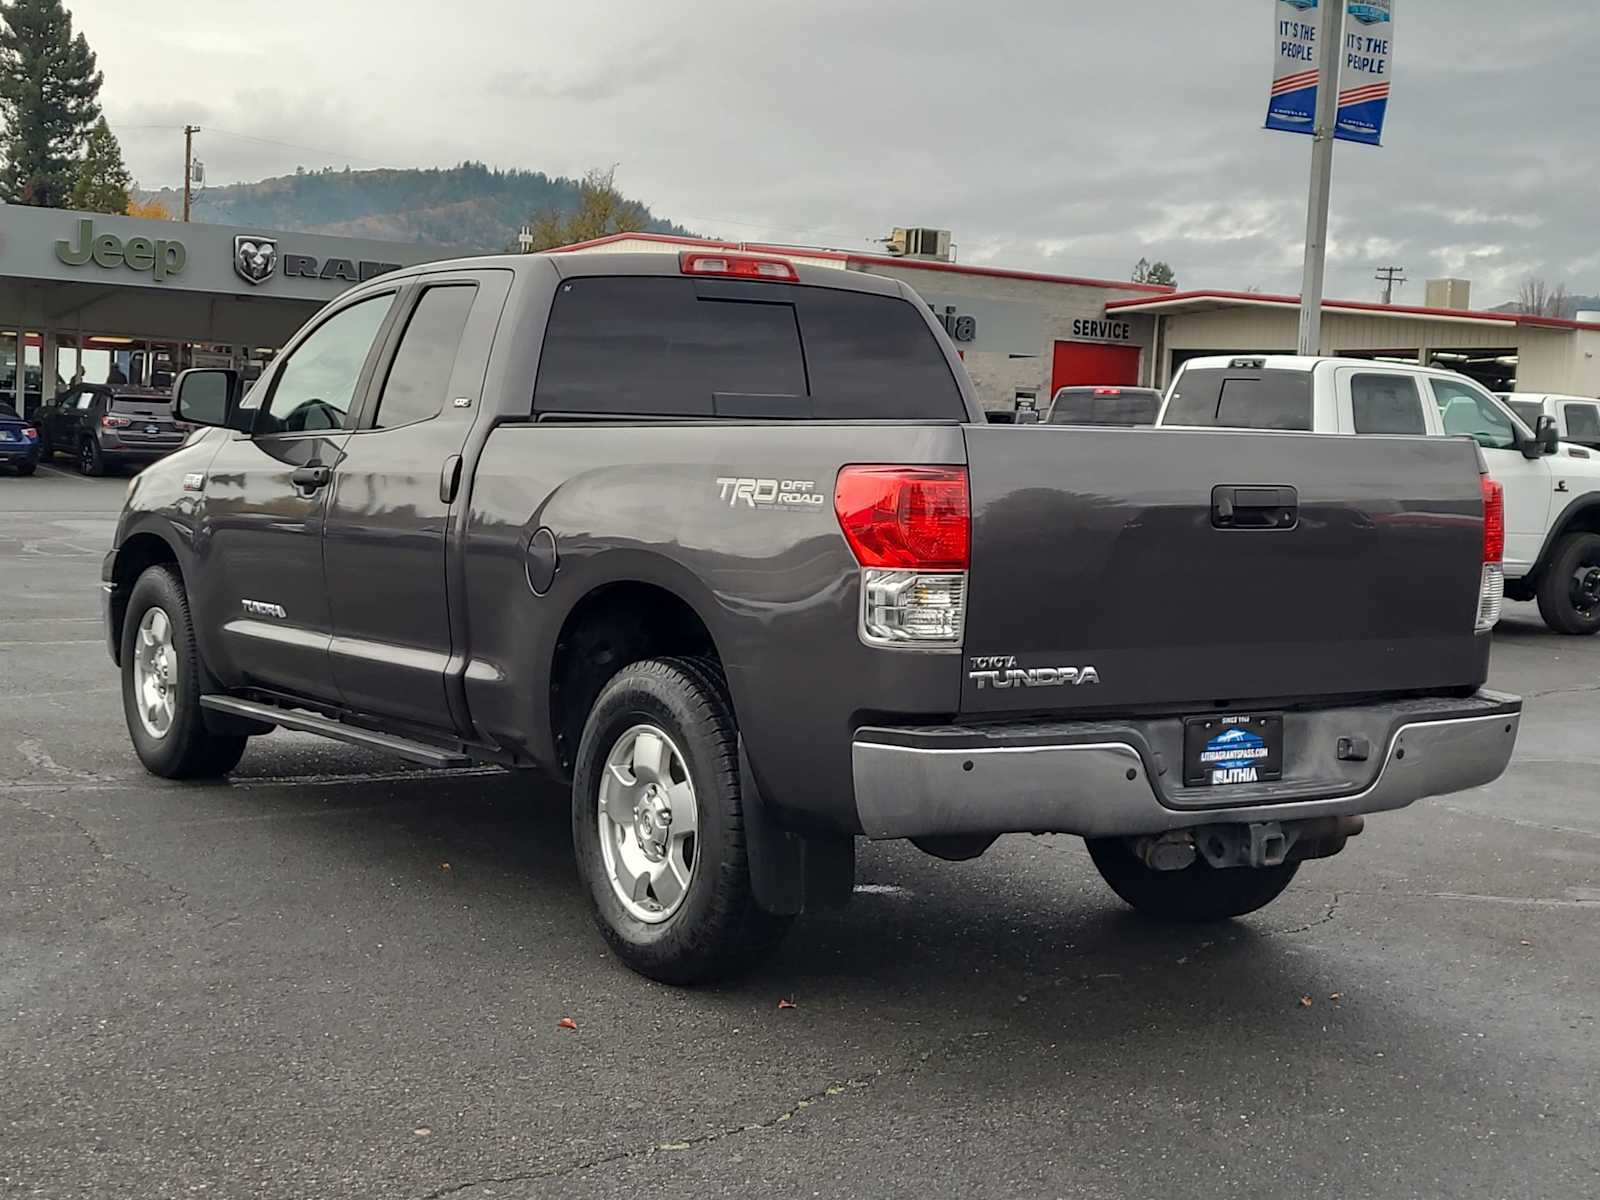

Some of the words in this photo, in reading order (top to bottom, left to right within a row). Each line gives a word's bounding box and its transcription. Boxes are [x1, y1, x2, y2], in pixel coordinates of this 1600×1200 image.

[1279, 20, 1298, 37] IT'S
[1299, 23, 1316, 42] THE
[1281, 41, 1313, 61] PEOPLE
[1365, 37, 1388, 55] THE
[1347, 53, 1385, 74] PEOPLE
[55, 218, 187, 282] Jeep
[1072, 319, 1130, 340] SERVICE
[716, 477, 778, 508] TRD
[780, 480, 815, 491] OFF
[777, 492, 825, 504] ROAD
[969, 656, 1018, 668] TOYOTA
[969, 666, 1100, 689] TUNDRA
[1224, 768, 1258, 783] LITHIA
